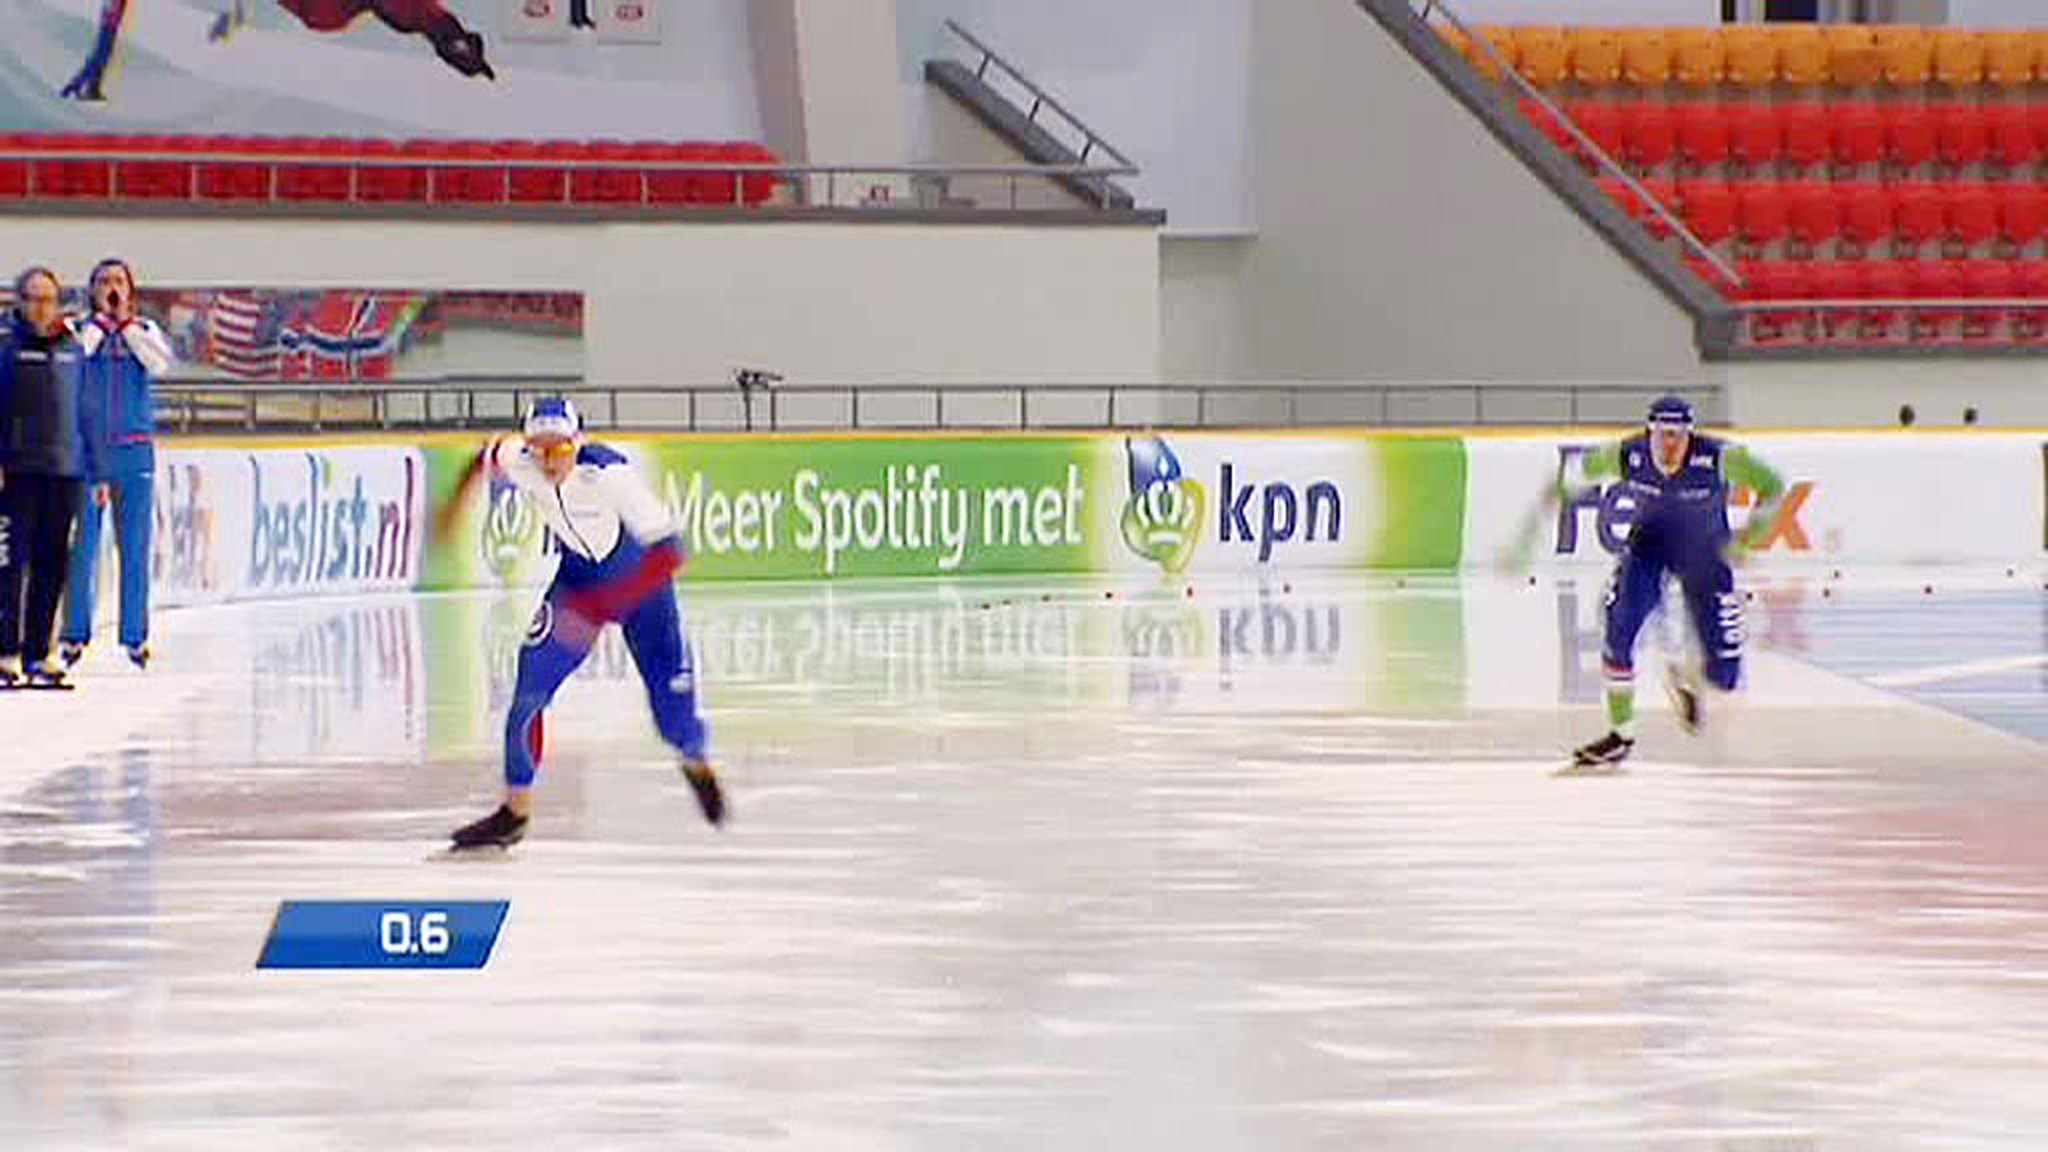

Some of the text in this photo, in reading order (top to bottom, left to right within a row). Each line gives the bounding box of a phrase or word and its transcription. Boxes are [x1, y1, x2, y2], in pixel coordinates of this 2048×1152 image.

[249, 453, 414, 585] beslist.nl
[663, 464, 1084, 573] Meer Spotify met
[1218, 463, 1342, 562] kpn
